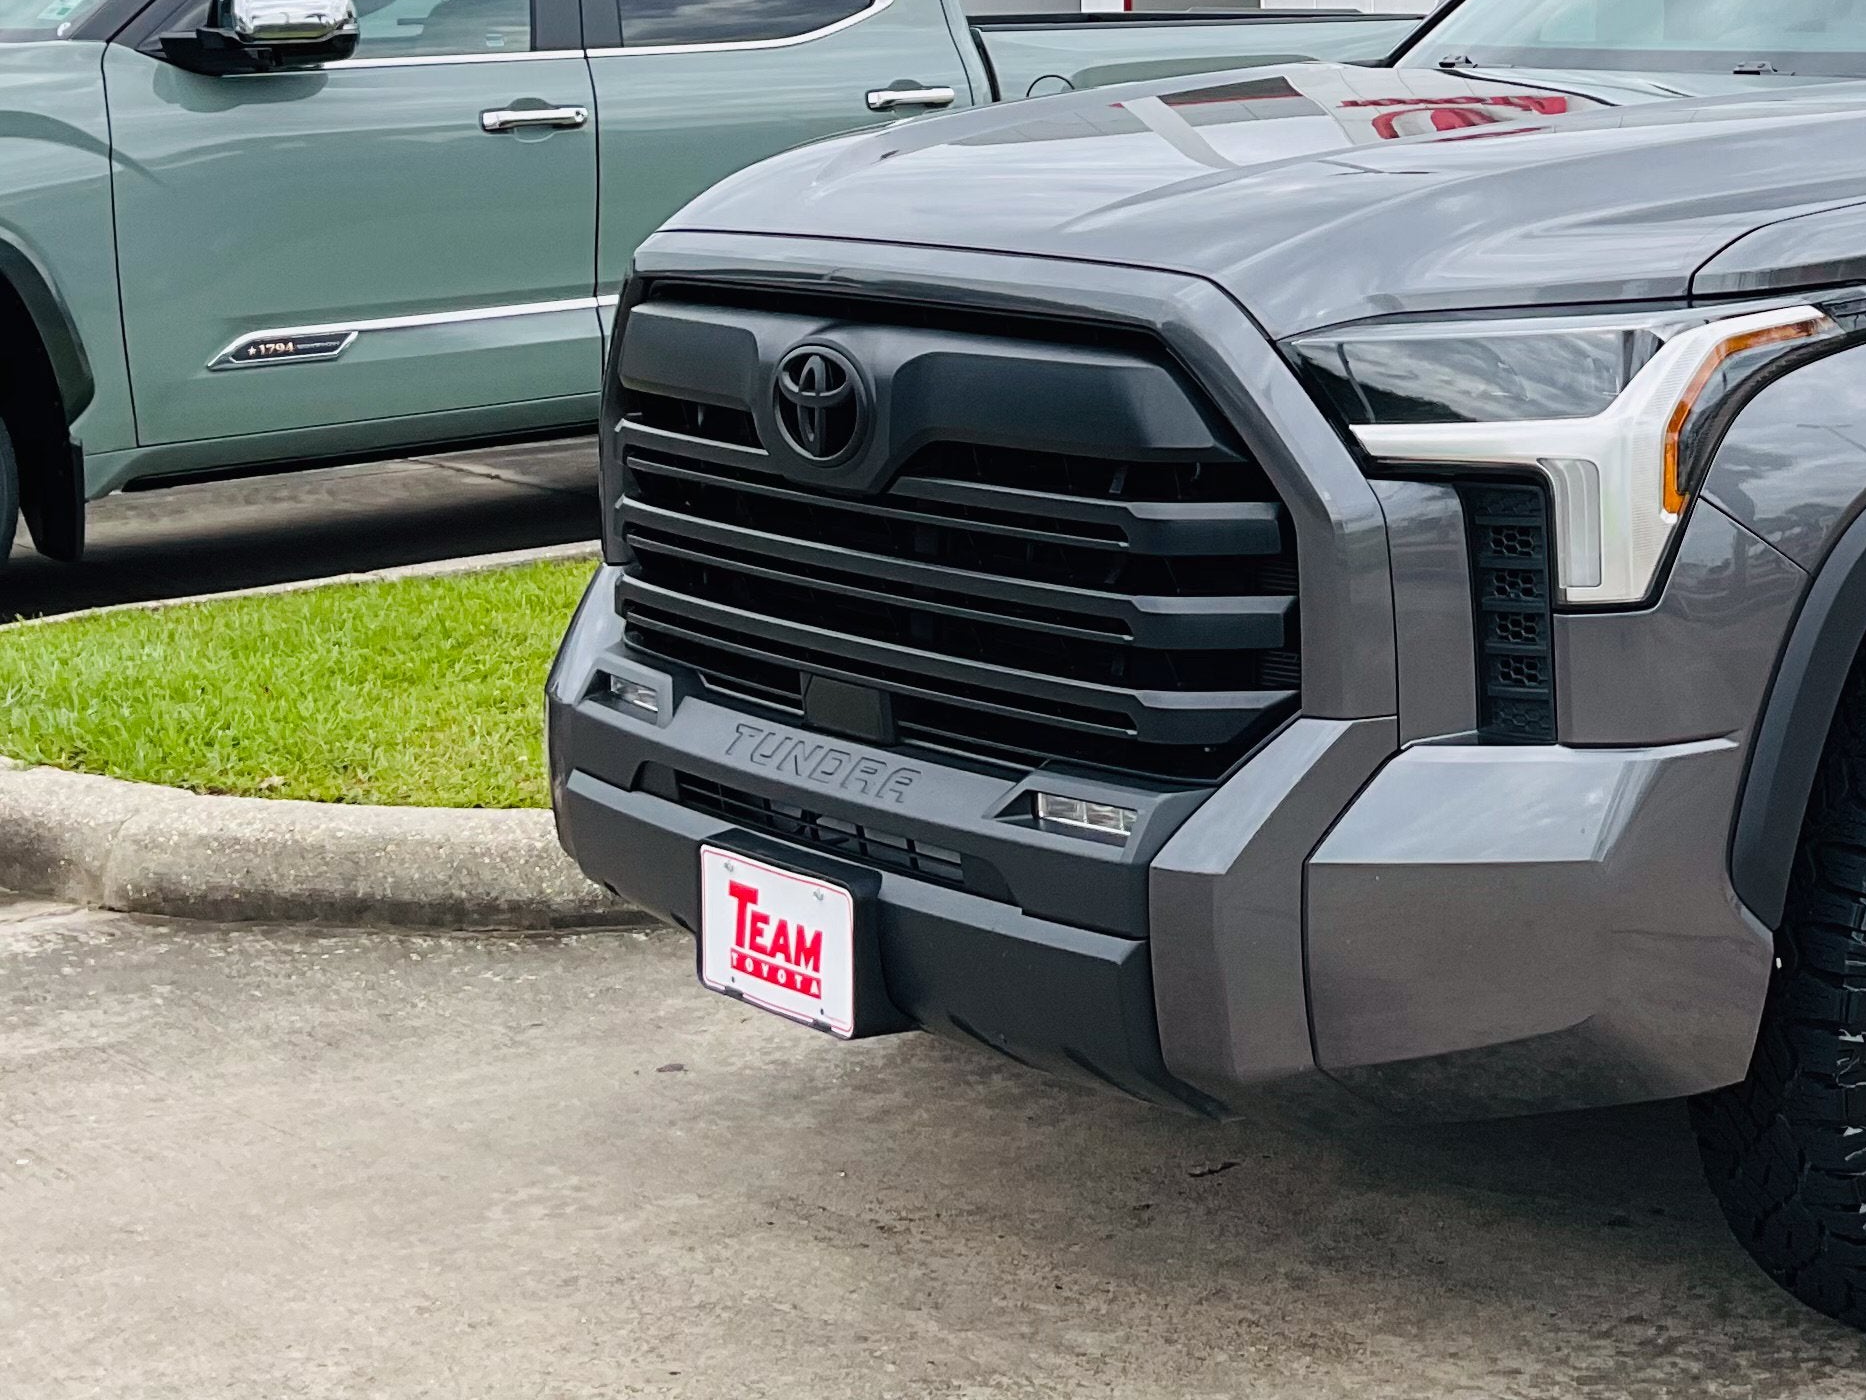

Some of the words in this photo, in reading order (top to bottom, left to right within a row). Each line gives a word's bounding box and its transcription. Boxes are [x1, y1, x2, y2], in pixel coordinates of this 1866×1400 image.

[257, 340, 295, 356] 1794
[725, 723, 922, 803] TUNDRA
[728, 879, 823, 973] TEAM
[730, 951, 821, 996] TOYOTA
